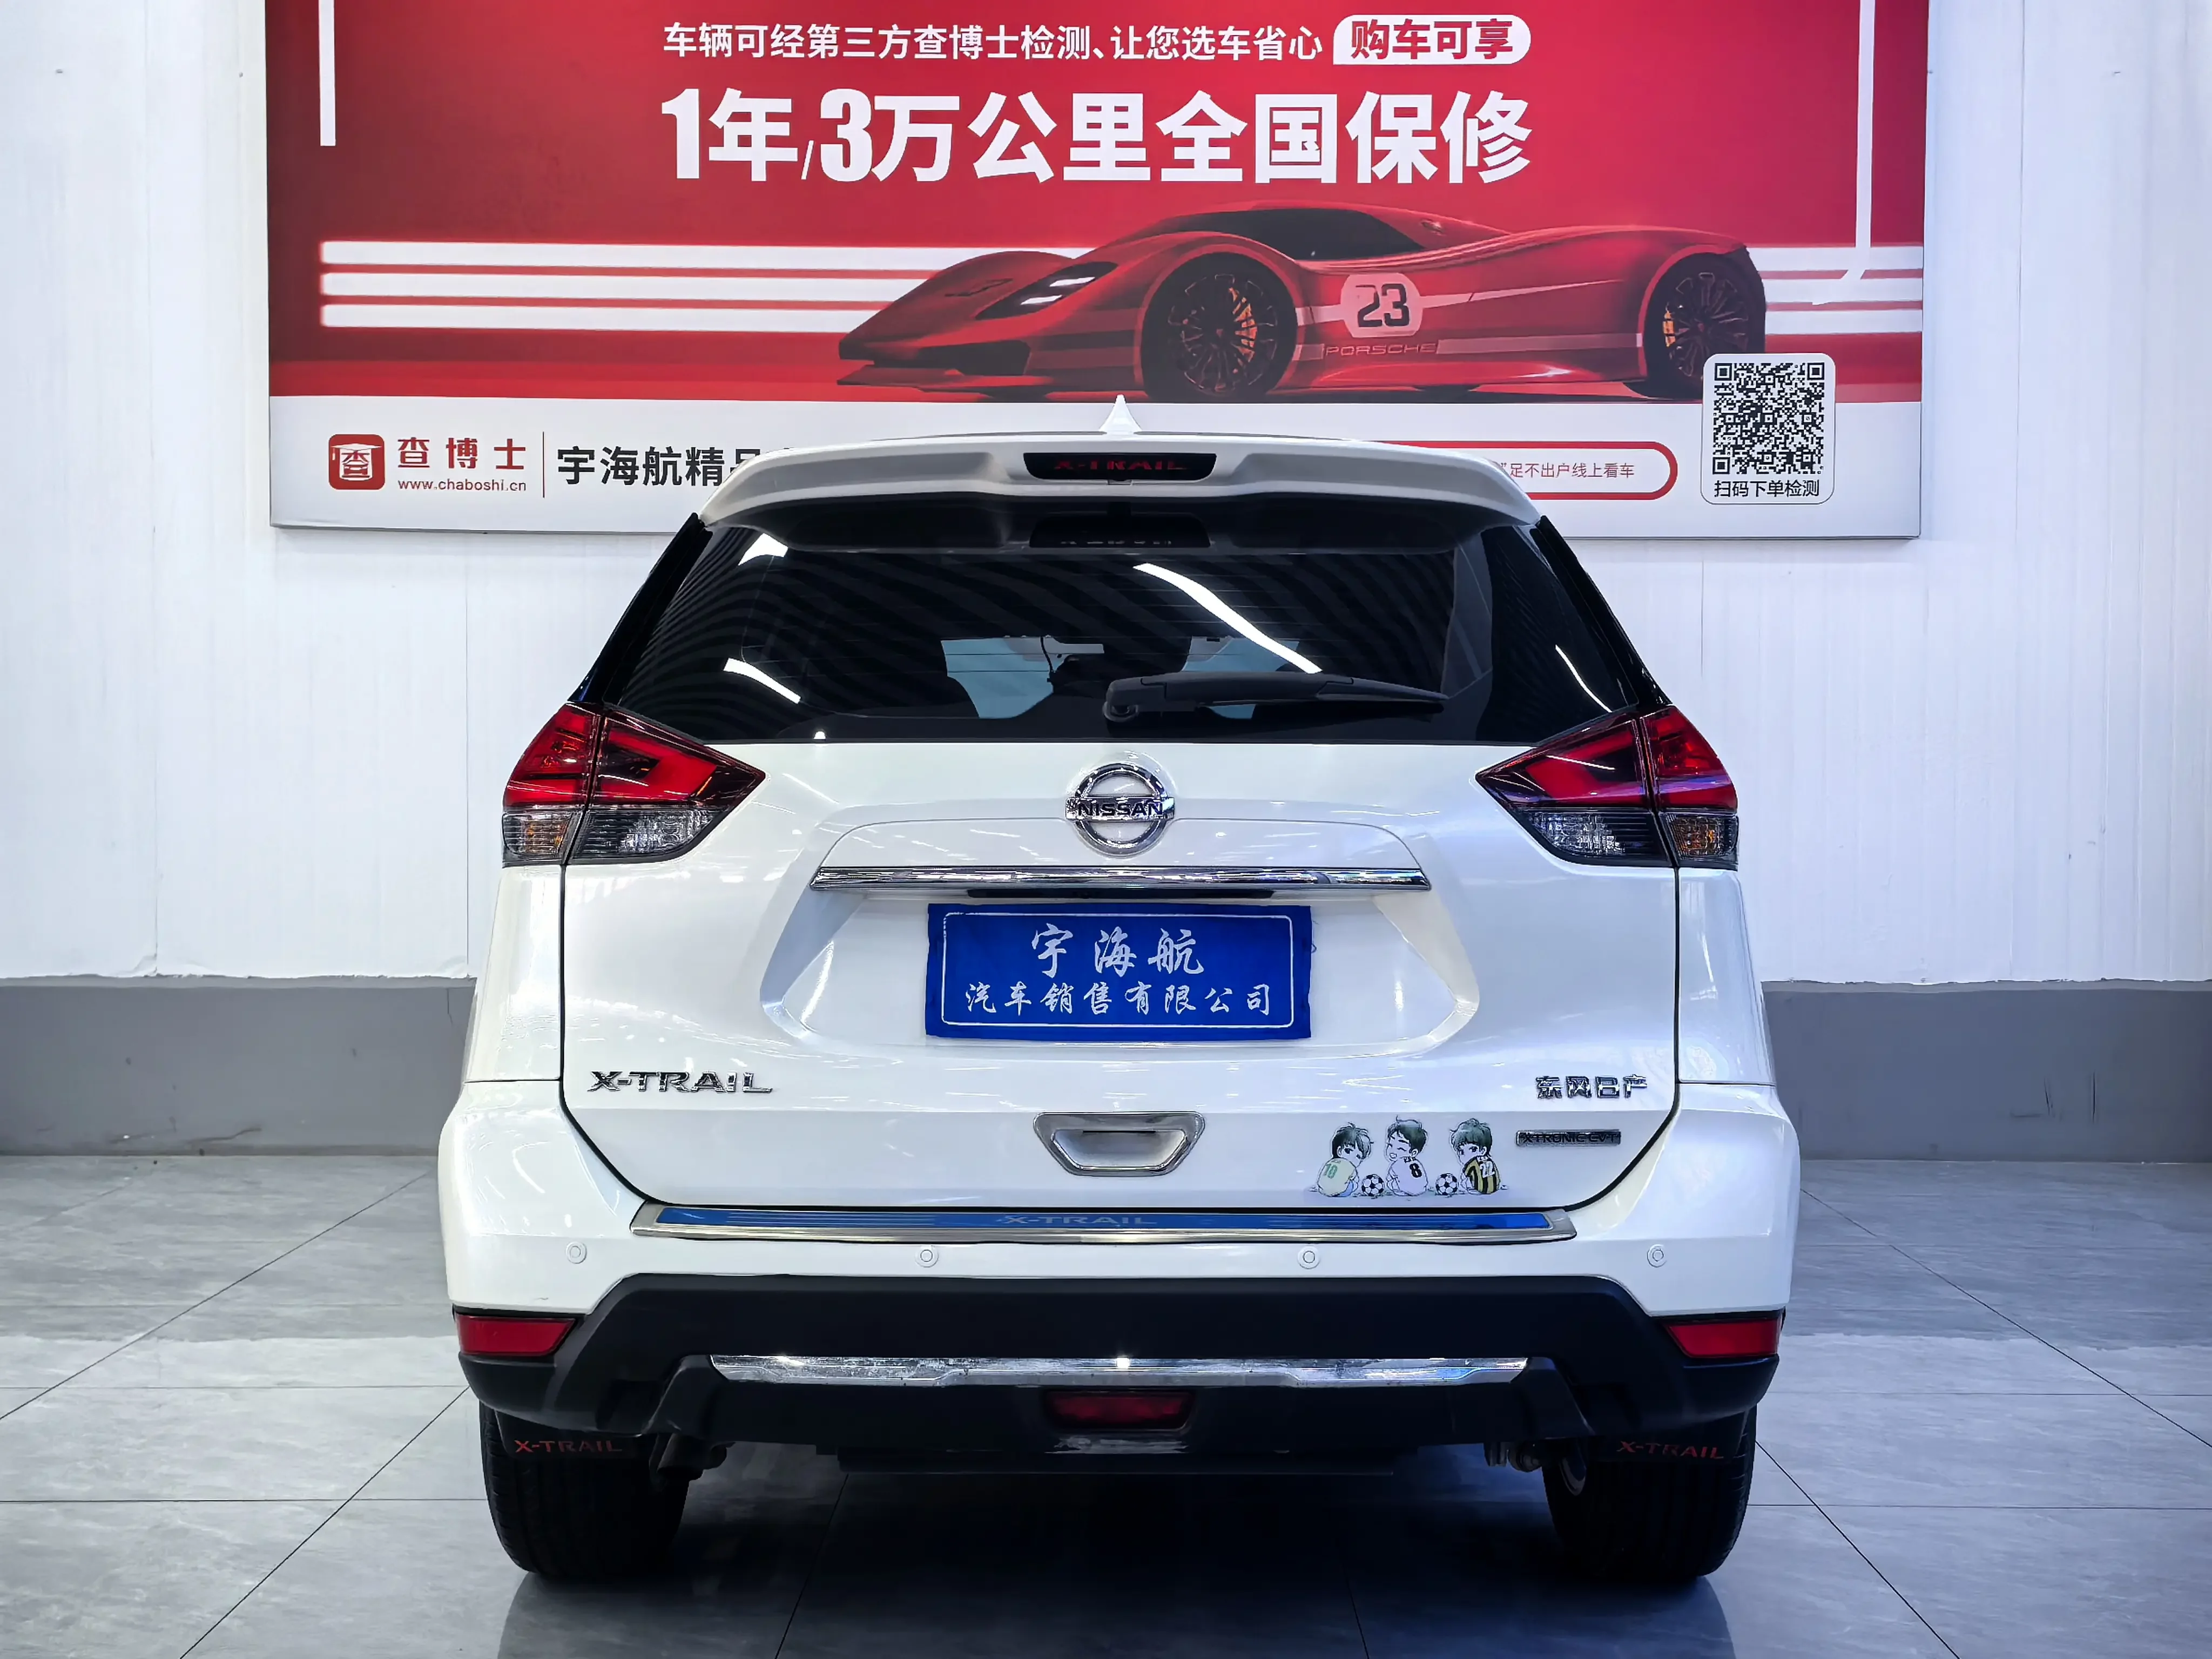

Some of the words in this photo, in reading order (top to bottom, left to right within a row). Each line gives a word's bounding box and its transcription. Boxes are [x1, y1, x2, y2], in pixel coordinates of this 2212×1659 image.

[663, 23, 1323, 62] 车辆可经第三方查博士检测、让您选车省心
[1351, 19, 1513, 59] 购车可享
[662, 87, 1532, 184] 1年/3万公里全国保修
[1355, 283, 1410, 327] 23
[1325, 343, 1437, 356] PORSCHE
[397, 436, 527, 469] 查博士
[397, 478, 526, 491] www.chaboshi.cn
[1714, 480, 1819, 497] 扫码下单检测
[1077, 802, 1163, 817] NISSAN
[1031, 923, 1204, 978] 宇海航
[965, 981, 1270, 1015] 汽车销售有限公司
[588, 1071, 773, 1092] X-TRAIL
[1536, 1074, 1648, 1098] 东风日产
[1409, 1163, 1422, 1178] 8
[1001, 1216, 1157, 1224] X-TRAIL
[515, 1440, 623, 1453] X-TRAIL
[1616, 1441, 1724, 1459] X-TRAIL
